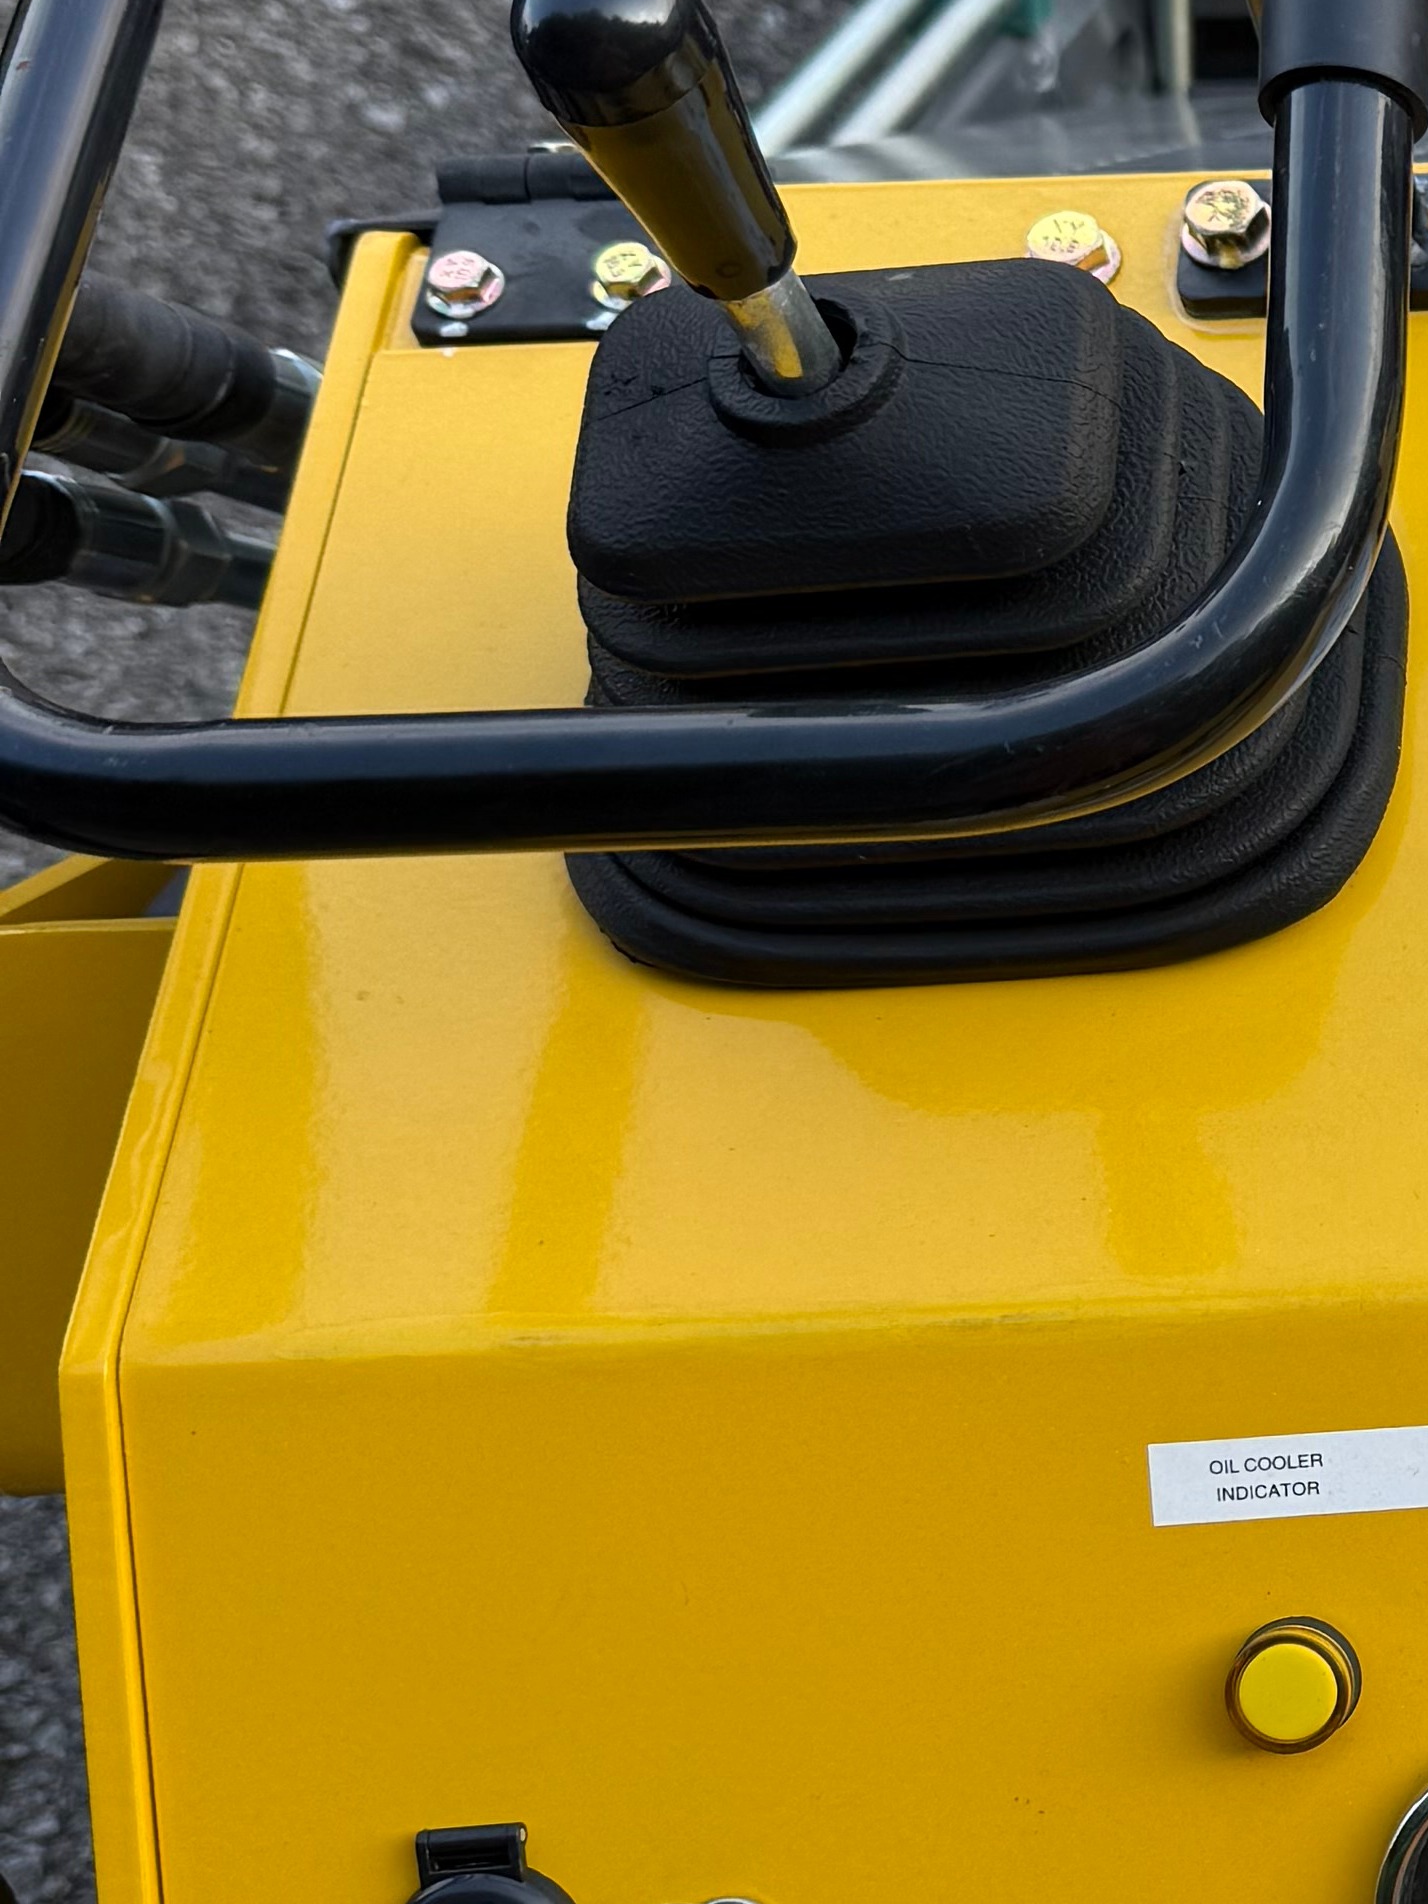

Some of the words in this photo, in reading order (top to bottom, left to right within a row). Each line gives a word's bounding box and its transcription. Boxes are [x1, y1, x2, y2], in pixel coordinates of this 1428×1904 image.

[1208, 1457, 1241, 1475] OIL
[1243, 1452, 1324, 1473] COOLER
[1216, 1480, 1321, 1503] INDICATOR
